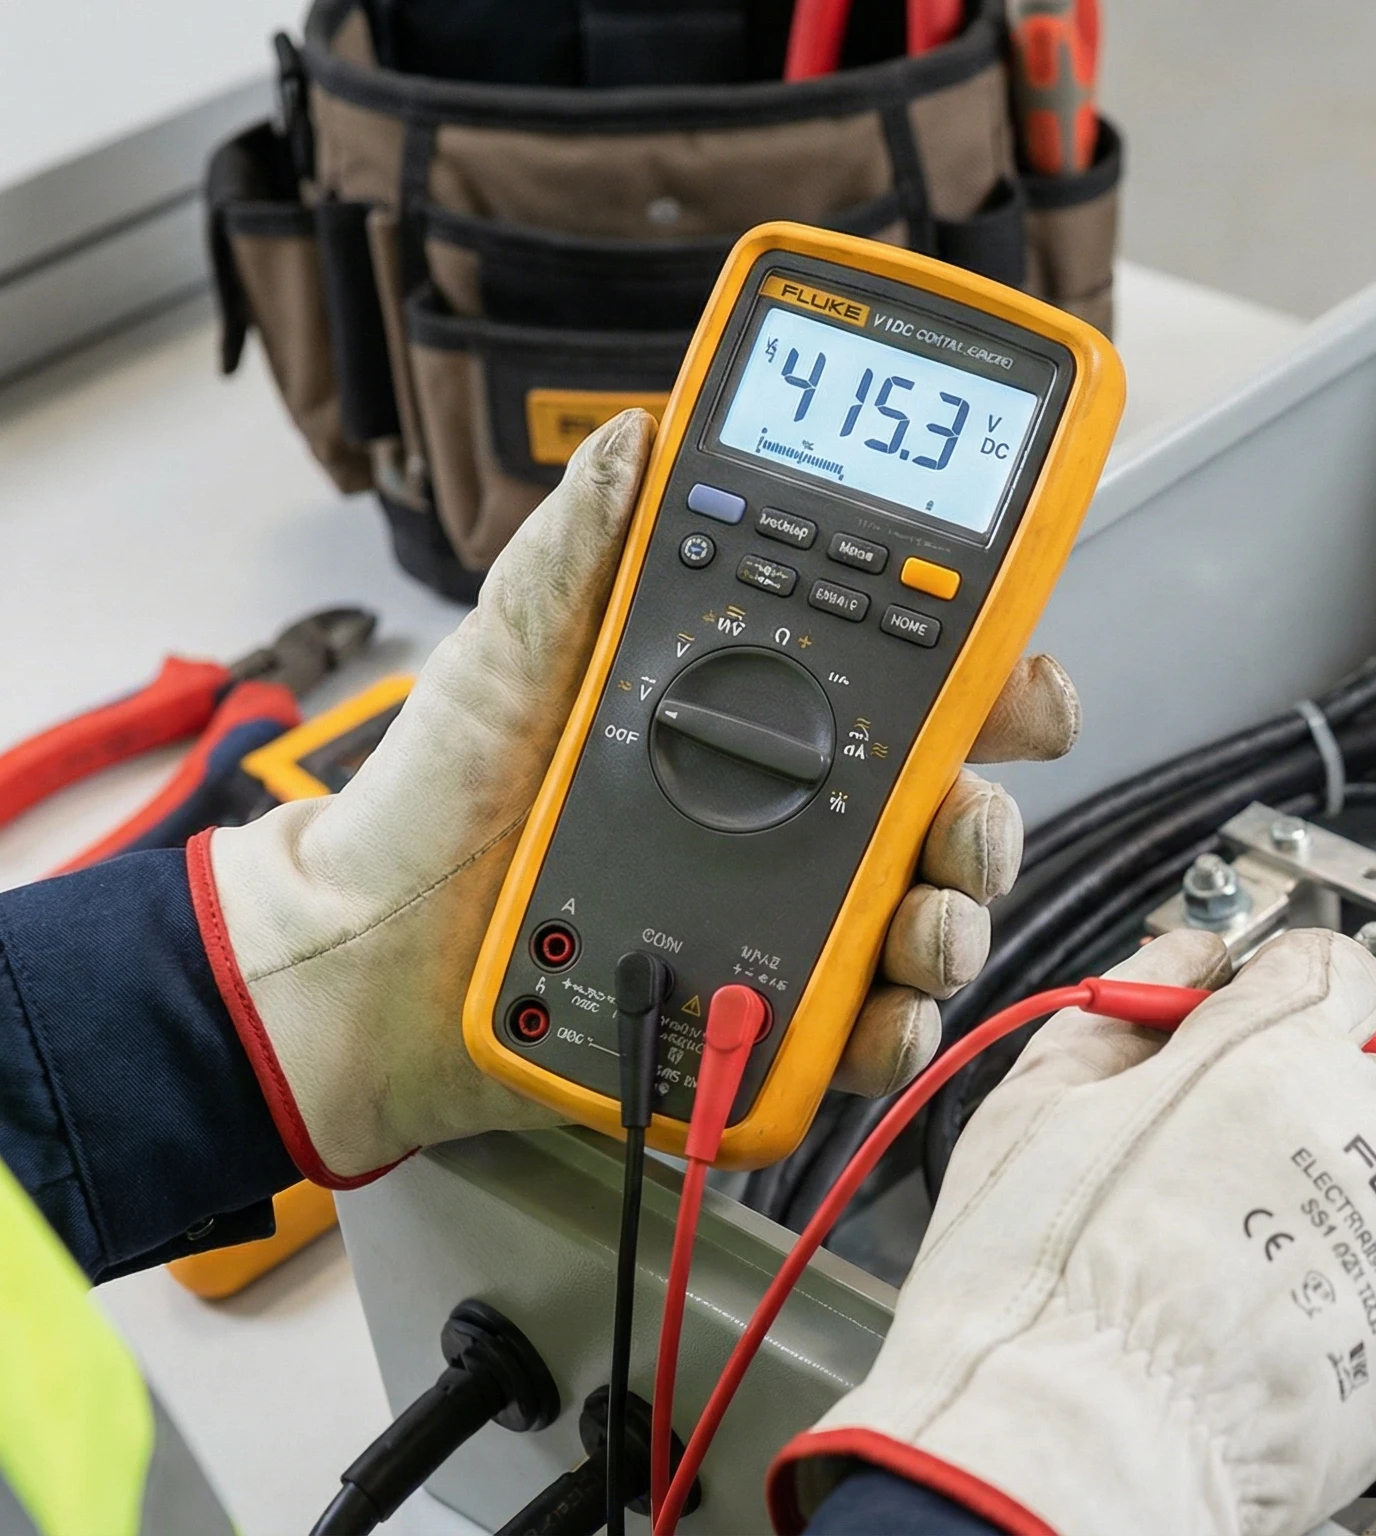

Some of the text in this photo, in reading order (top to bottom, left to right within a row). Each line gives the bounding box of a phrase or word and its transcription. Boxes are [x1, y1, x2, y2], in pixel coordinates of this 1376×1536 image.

[780, 284, 863, 322] FLUKE
[780, 346, 971, 472] 415.3
[985, 413, 1004, 433] V
[980, 436, 1011, 461] DC
[561, 897, 576, 916] A
